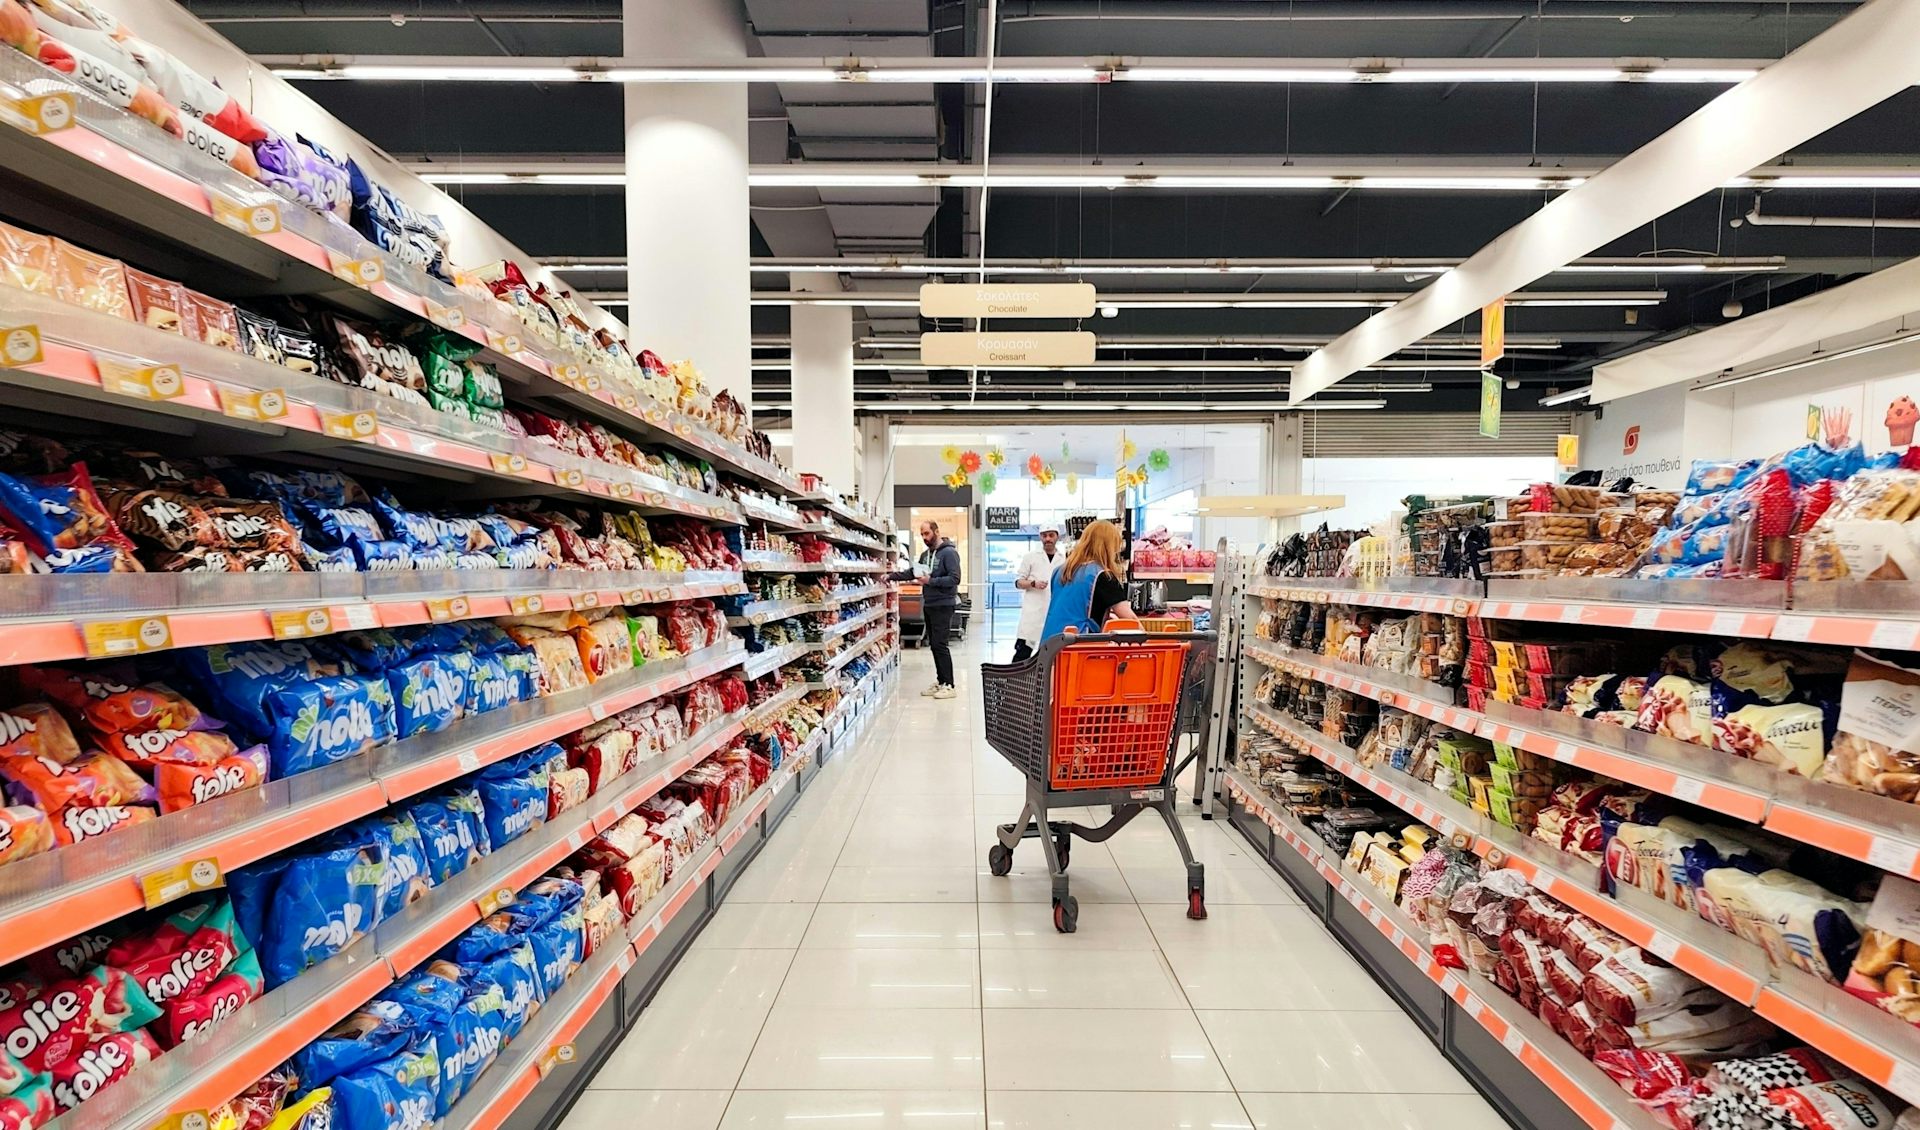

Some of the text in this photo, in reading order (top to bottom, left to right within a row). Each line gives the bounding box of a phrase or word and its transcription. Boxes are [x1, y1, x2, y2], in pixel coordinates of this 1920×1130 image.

[976, 290, 1040, 303] Σοκολάτες
[988, 305, 1028, 313] Chocolate
[977, 336, 1039, 352] Κρουασάν
[989, 353, 1026, 361] Croissant
[1628, 464, 1643, 477] όσο
[1645, 456, 1681, 475] πουθενά
[214, 512, 271, 539] folie
[990, 507, 1018, 516] MARK
[191, 764, 246, 805] folie
[502, 797, 545, 835] molto
[146, 948, 215, 1003] folie
[0, 990, 82, 1059] olie
[182, 993, 239, 1041] folie
[443, 1027, 501, 1081] molto
[54, 1041, 128, 1109] folie
